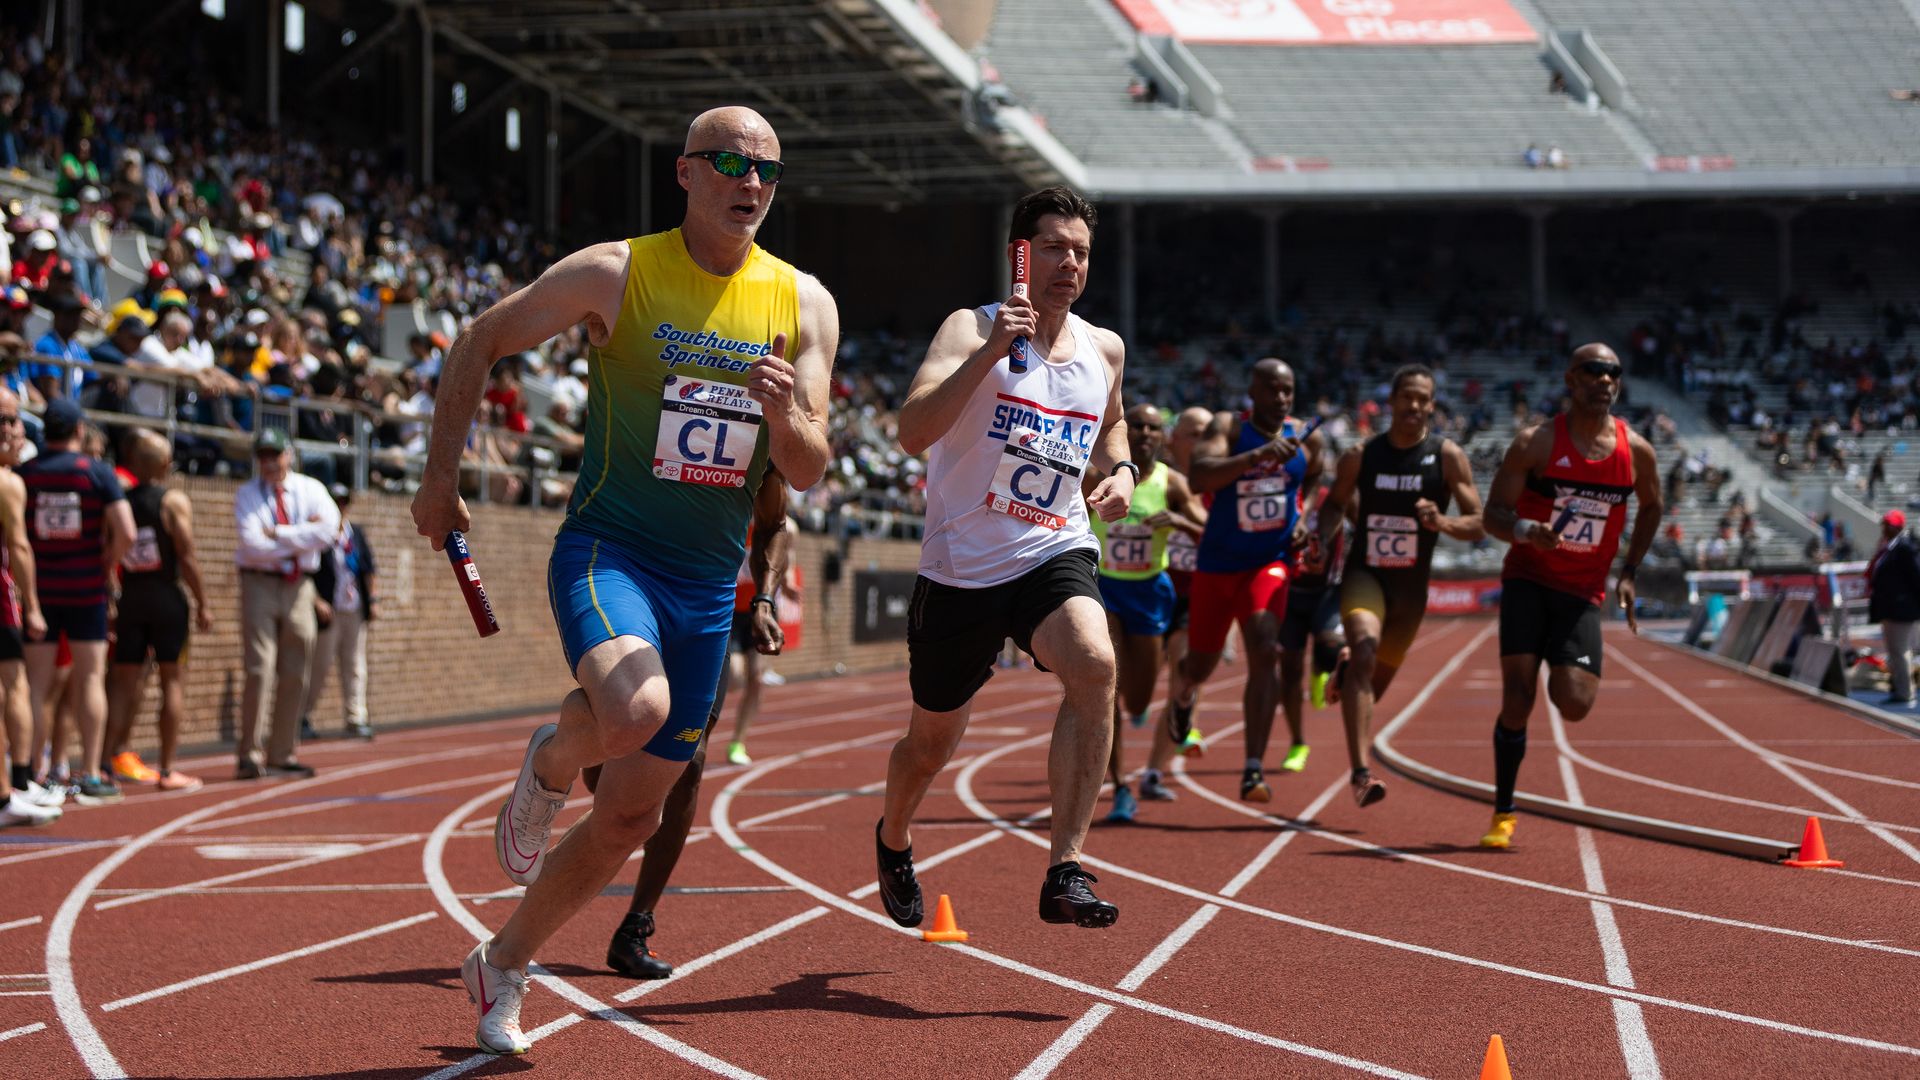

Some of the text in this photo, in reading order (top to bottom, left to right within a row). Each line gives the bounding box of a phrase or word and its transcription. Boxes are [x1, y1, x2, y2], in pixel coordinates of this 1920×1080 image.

[1345, 17, 1492, 40] Places
[1016, 245, 1025, 280] TOYOTA
[653, 323, 772, 356] Southwest
[659, 344, 752, 373] Sprinter
[707, 395, 752, 409] RELAYS
[710, 385, 745, 398] PENN
[679, 404, 705, 416] Dream
[678, 418, 735, 467] CL
[1041, 438, 1068, 452] PENN
[1016, 450, 1038, 462] Dream
[1039, 446, 1074, 462] RELAYS
[685, 467, 737, 485] TOYOTA
[1010, 464, 1062, 508] CJ
[1012, 503, 1058, 528] TOYOTA
[1246, 499, 1279, 520] CD
[1111, 541, 1145, 561] CH
[1375, 534, 1407, 556] CC
[477, 583, 496, 623] TOYOTA
